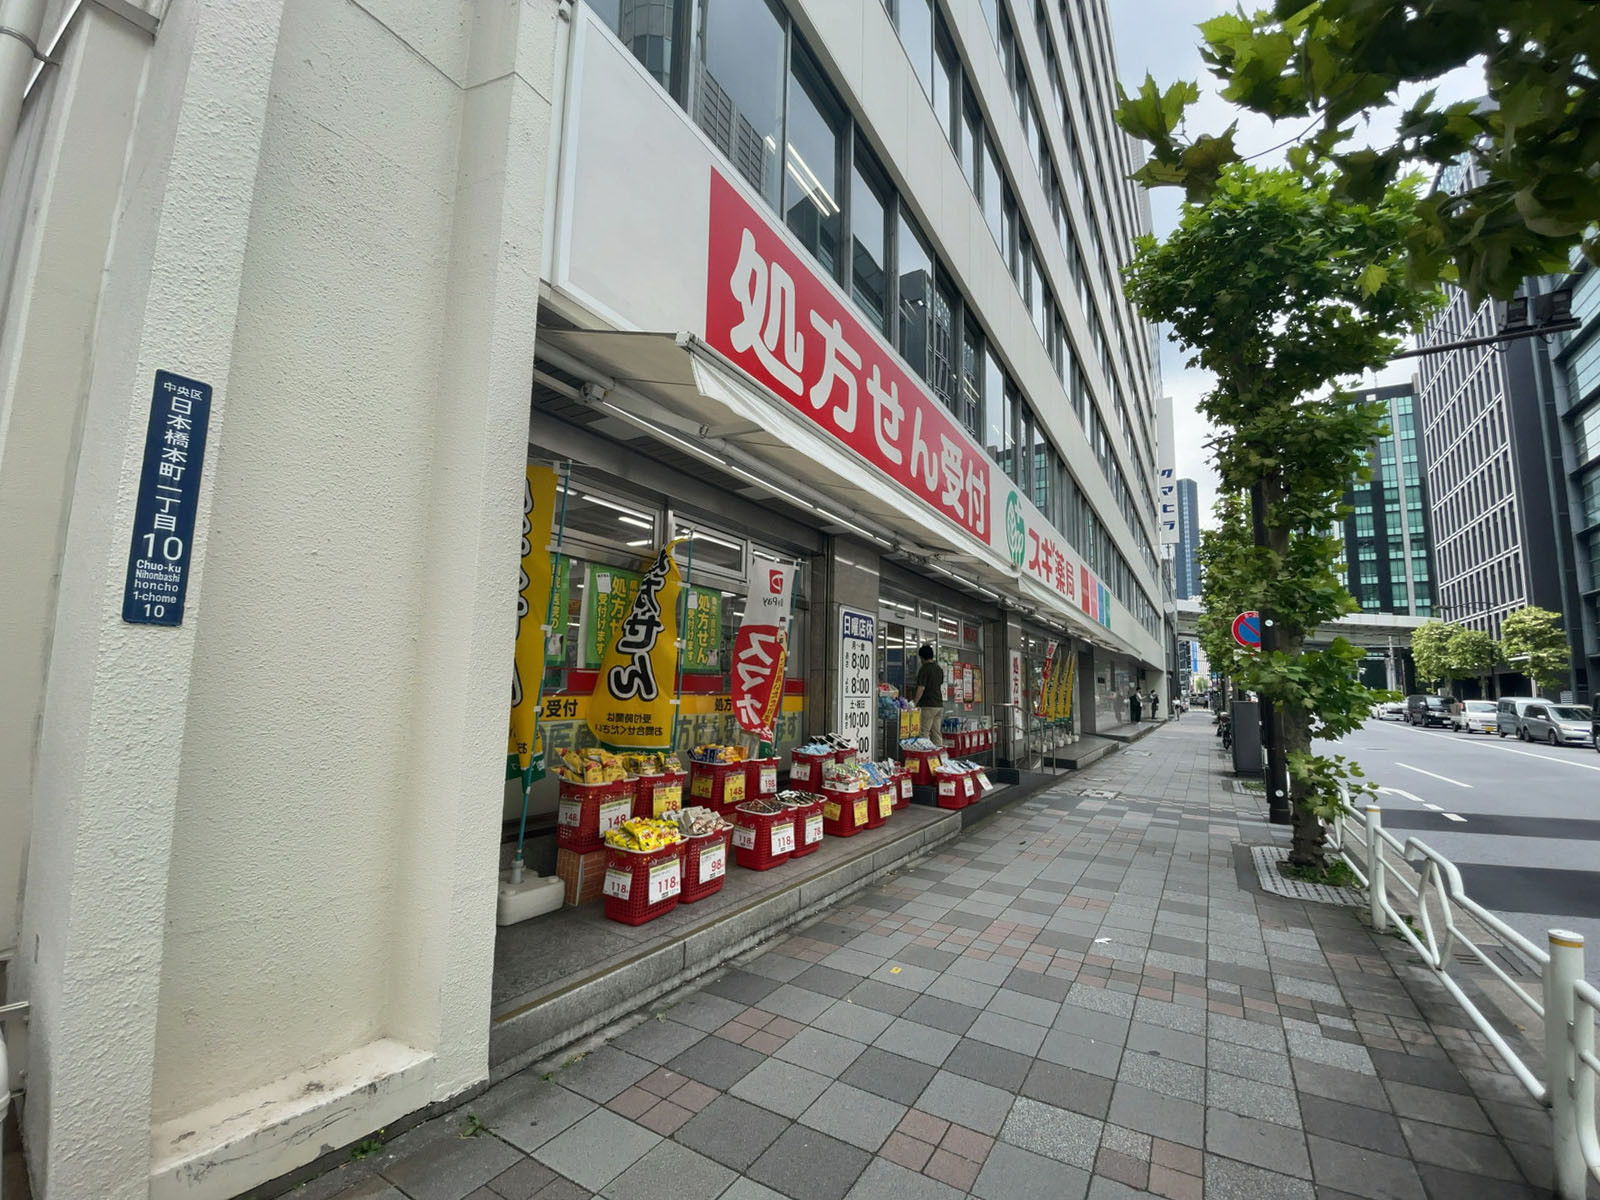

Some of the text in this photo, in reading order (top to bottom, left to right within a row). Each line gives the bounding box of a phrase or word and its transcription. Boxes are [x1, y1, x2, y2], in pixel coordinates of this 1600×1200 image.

[729, 227, 988, 535] 処方せん受付
[163, 381, 204, 401] 中央区
[153, 396, 193, 533] 日本橋本町一丁目
[1160, 468, 1176, 531] クマヒラ
[143, 532, 183, 560] 10
[136, 559, 182, 573] Chuo-ku
[1028, 527, 1075, 601] スギ薬局
[135, 569, 180, 583] Nihonbashi
[134, 579, 179, 592] honcho
[132, 591, 177, 604] 1-chome
[144, 604, 165, 618] 10
[696, 594, 711, 665] 処方せん
[844, 615, 874, 640] 日曜店休
[851, 653, 870, 670] 8:00
[851, 677, 870, 694] 8:00
[849, 712, 870, 728] 10:00
[777, 835, 792, 848] 118
[611, 881, 627, 894] 118
[658, 875, 677, 893] 118
